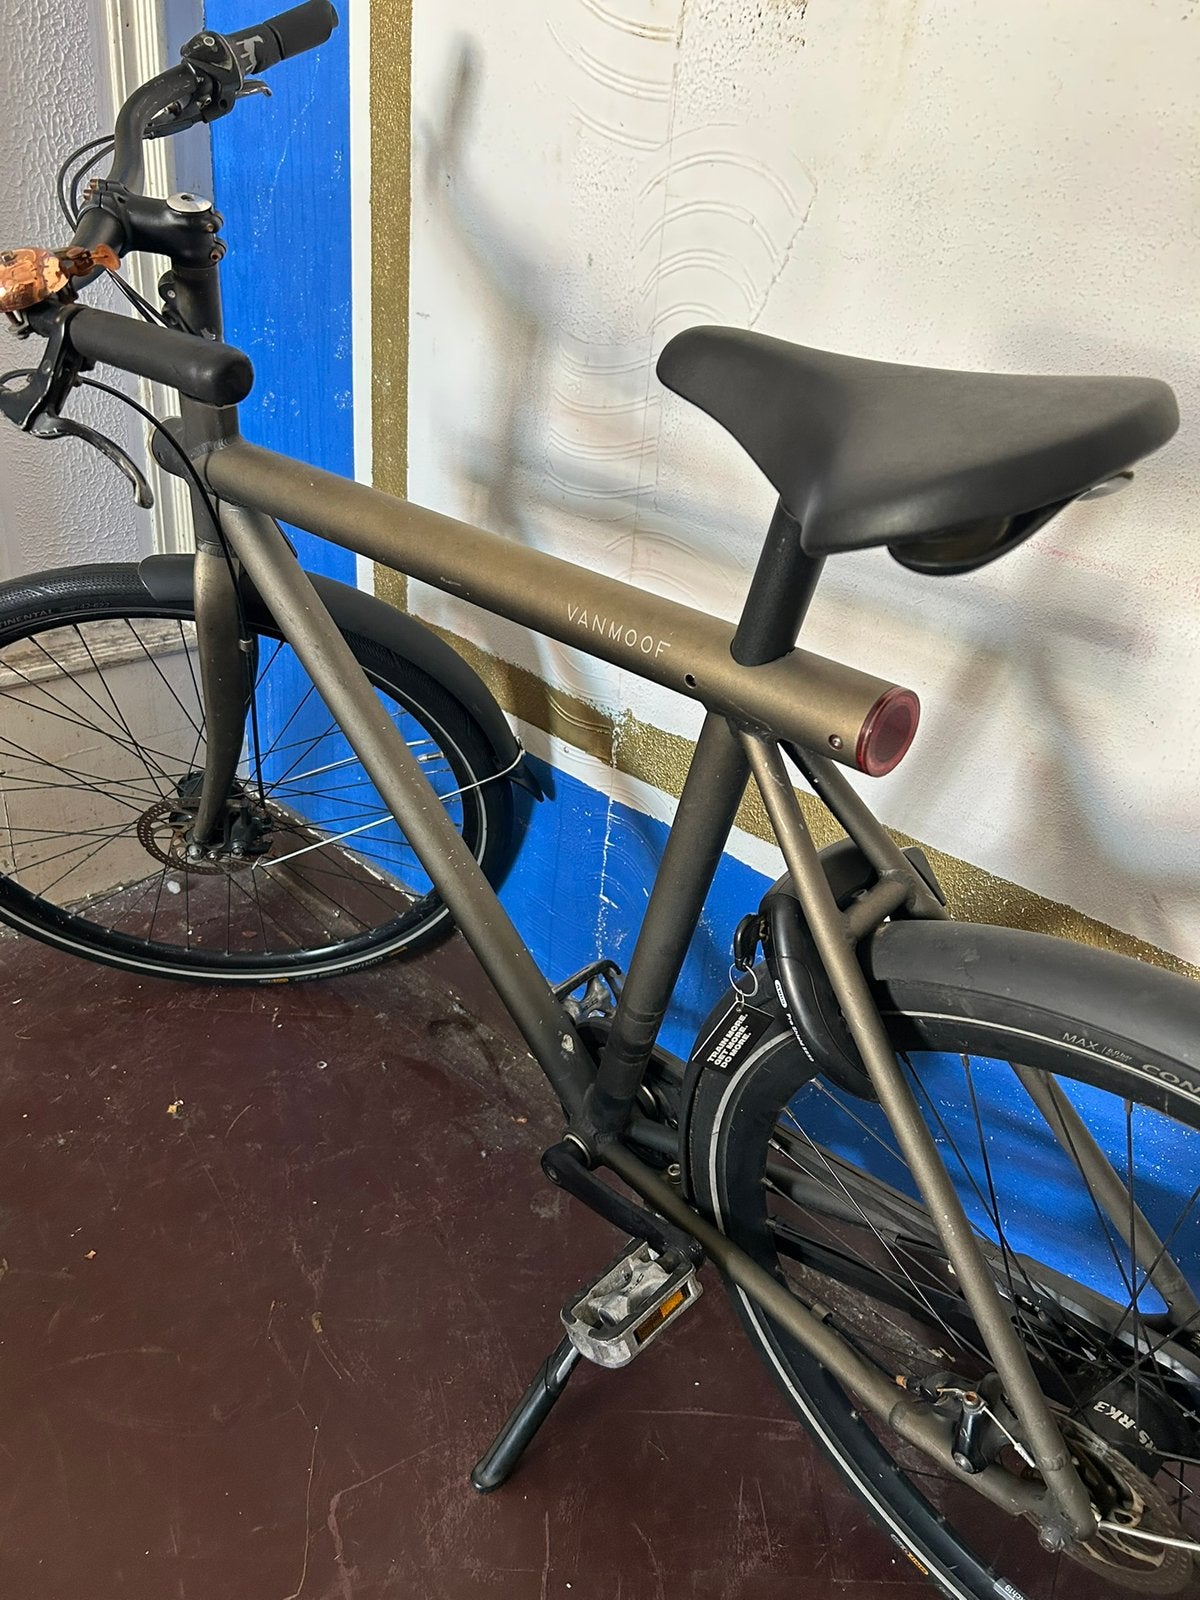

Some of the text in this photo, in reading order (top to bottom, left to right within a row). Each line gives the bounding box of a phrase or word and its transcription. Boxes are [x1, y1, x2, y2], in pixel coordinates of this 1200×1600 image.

[567, 603, 672, 658] VANMOOF
[706, 1014, 748, 1062] TRAIN MORE.
[713, 1025, 749, 1066] GET MORE.
[720, 1032, 752, 1069] DO MORE.
